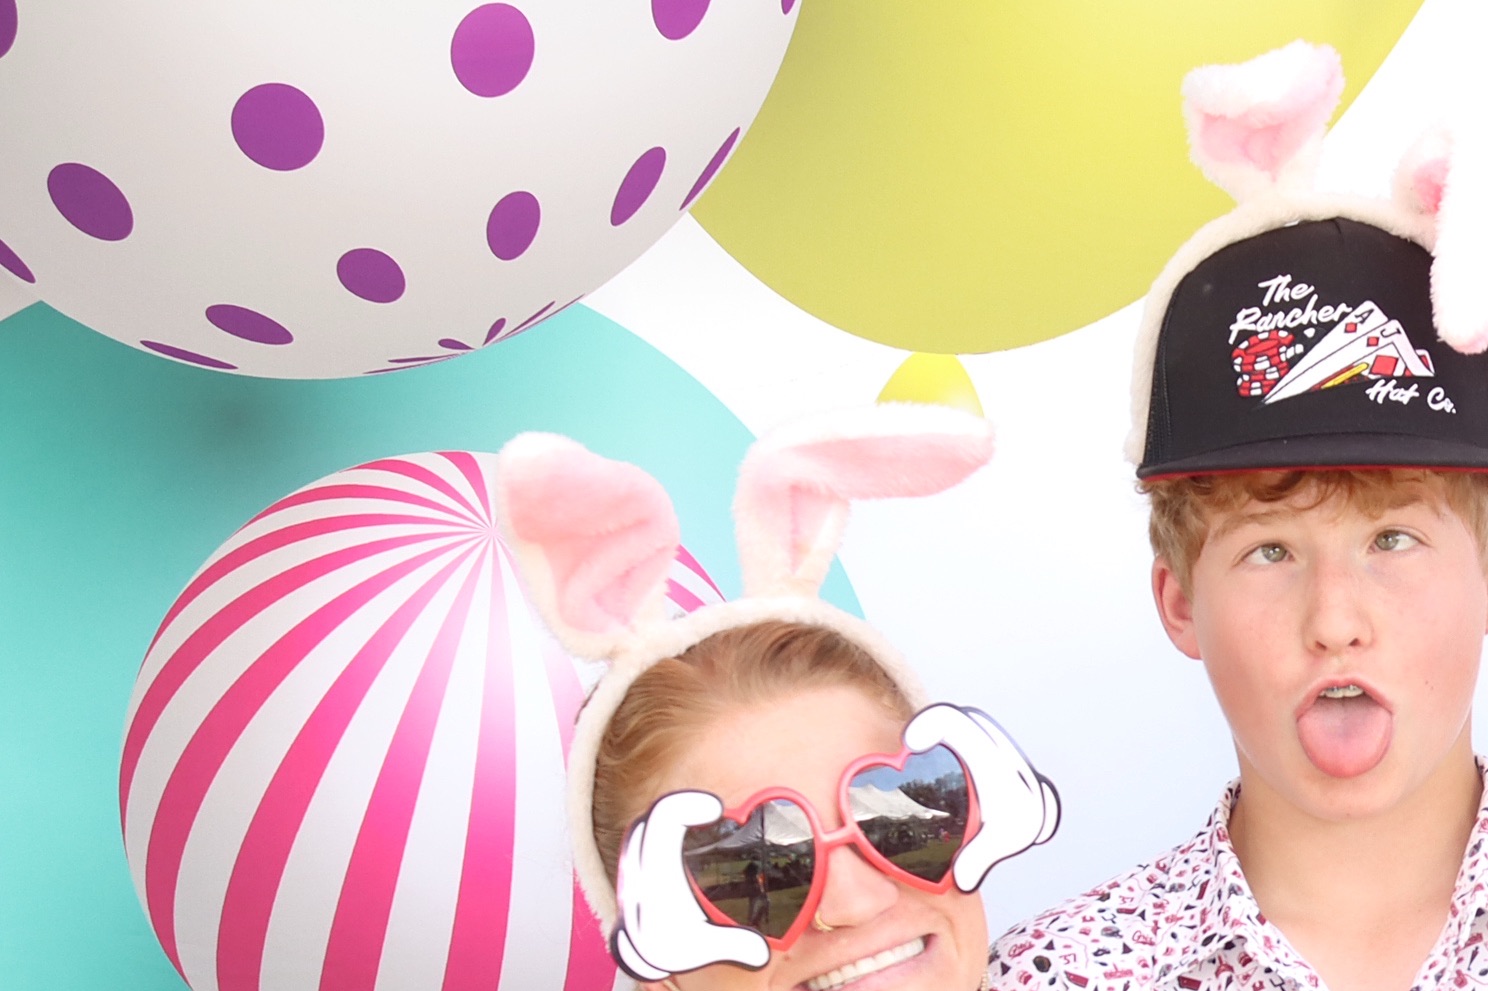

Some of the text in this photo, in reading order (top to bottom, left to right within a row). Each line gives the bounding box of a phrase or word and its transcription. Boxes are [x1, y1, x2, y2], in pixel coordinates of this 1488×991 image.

[1258, 273, 1315, 305] The
[1228, 294, 1352, 344] Rancher
[1365, 379, 1420, 405] Hat
[1060, 954, 1077, 965] 37
